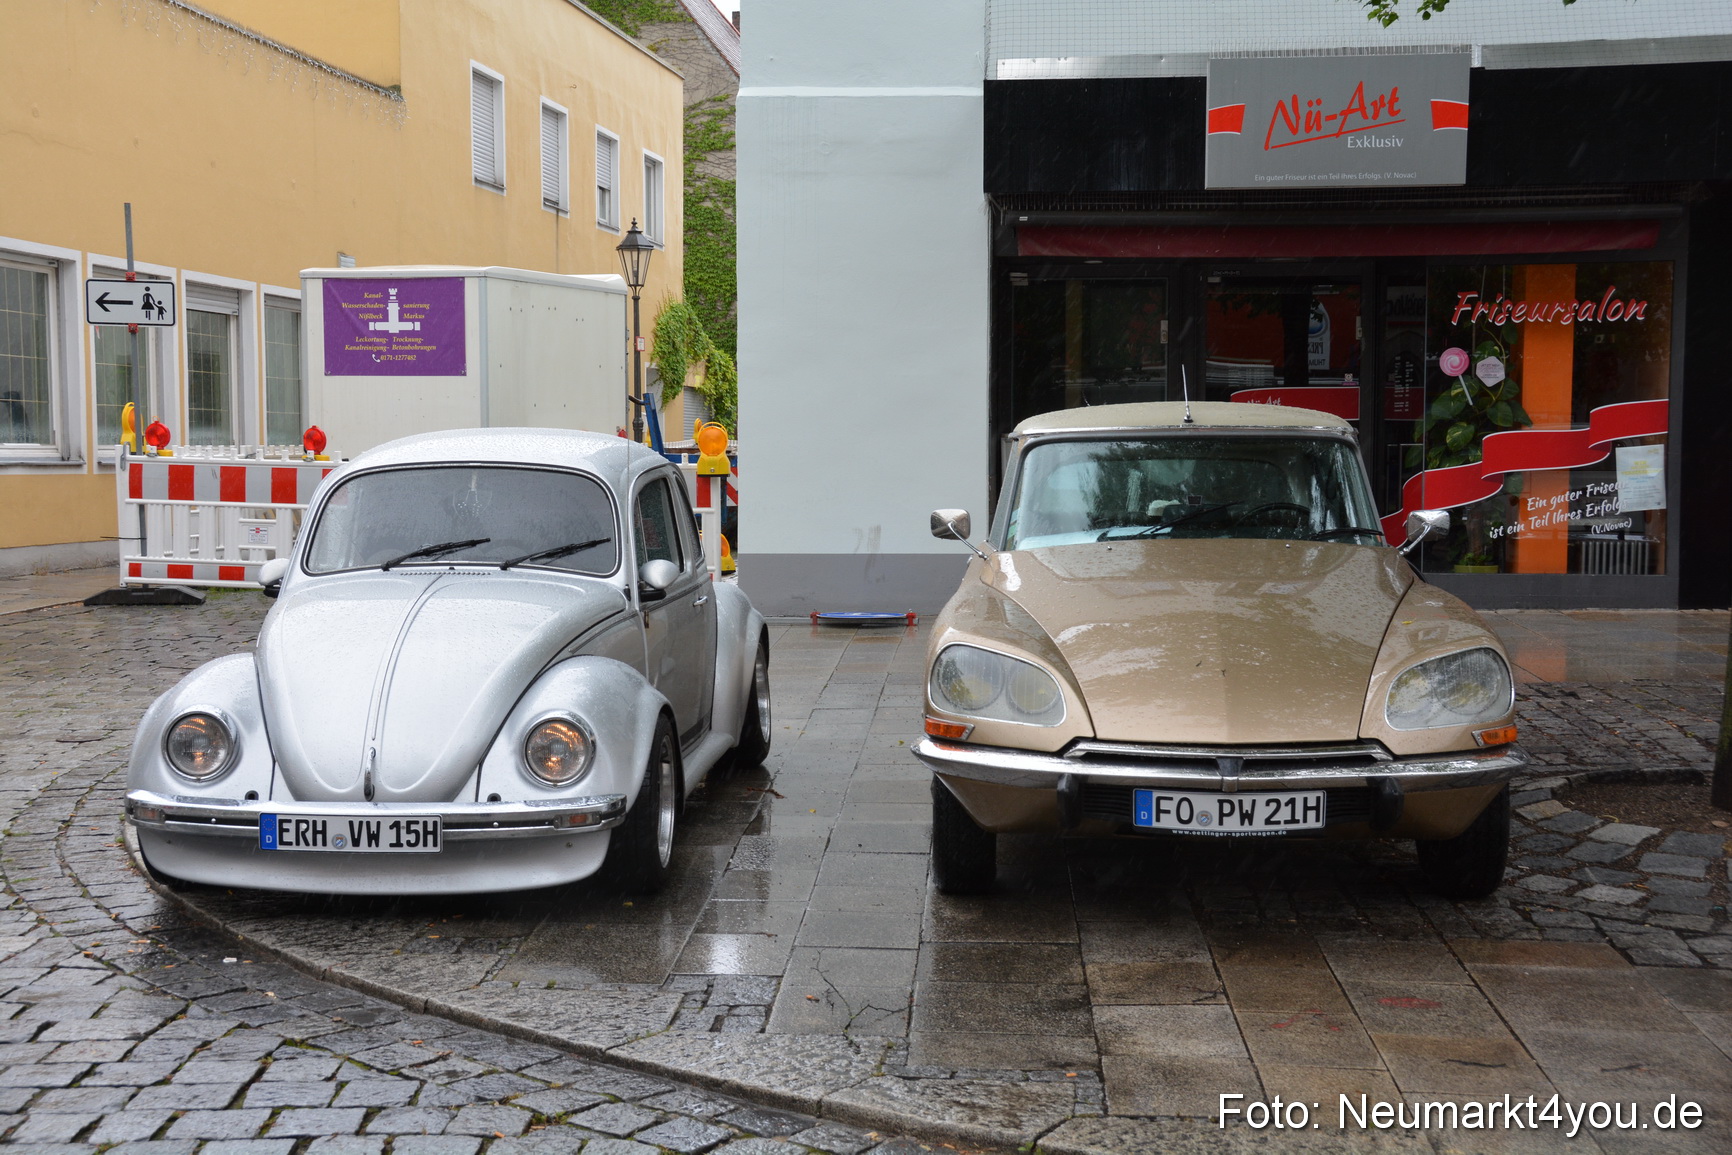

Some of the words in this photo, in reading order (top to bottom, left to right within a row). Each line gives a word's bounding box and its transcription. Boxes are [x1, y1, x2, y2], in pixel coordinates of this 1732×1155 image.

[1264, 81, 1404, 151] Nü-Art
[1347, 136, 1404, 148] Exklusiv
[1359, 172, 1382, 181] Erfolgs.
[1451, 285, 1648, 326] Friseursalon
[1527, 496, 1548, 512] Ein
[1550, 486, 1583, 509] guter
[1489, 522, 1504, 540] ist
[1506, 520, 1525, 537] ein
[1528, 512, 1550, 530] Teil
[1552, 506, 1582, 524] Ihres
[1591, 517, 1632, 536] (V.Novac)
[1140, 811, 1148, 820] D
[1155, 795, 1195, 825] FO
[1216, 797, 1257, 826] PW
[1264, 795, 1322, 826] 21H
[266, 835, 272, 844] D
[278, 818, 328, 847] ERH
[348, 820, 381, 848] VW
[389, 820, 438, 848] 15H
